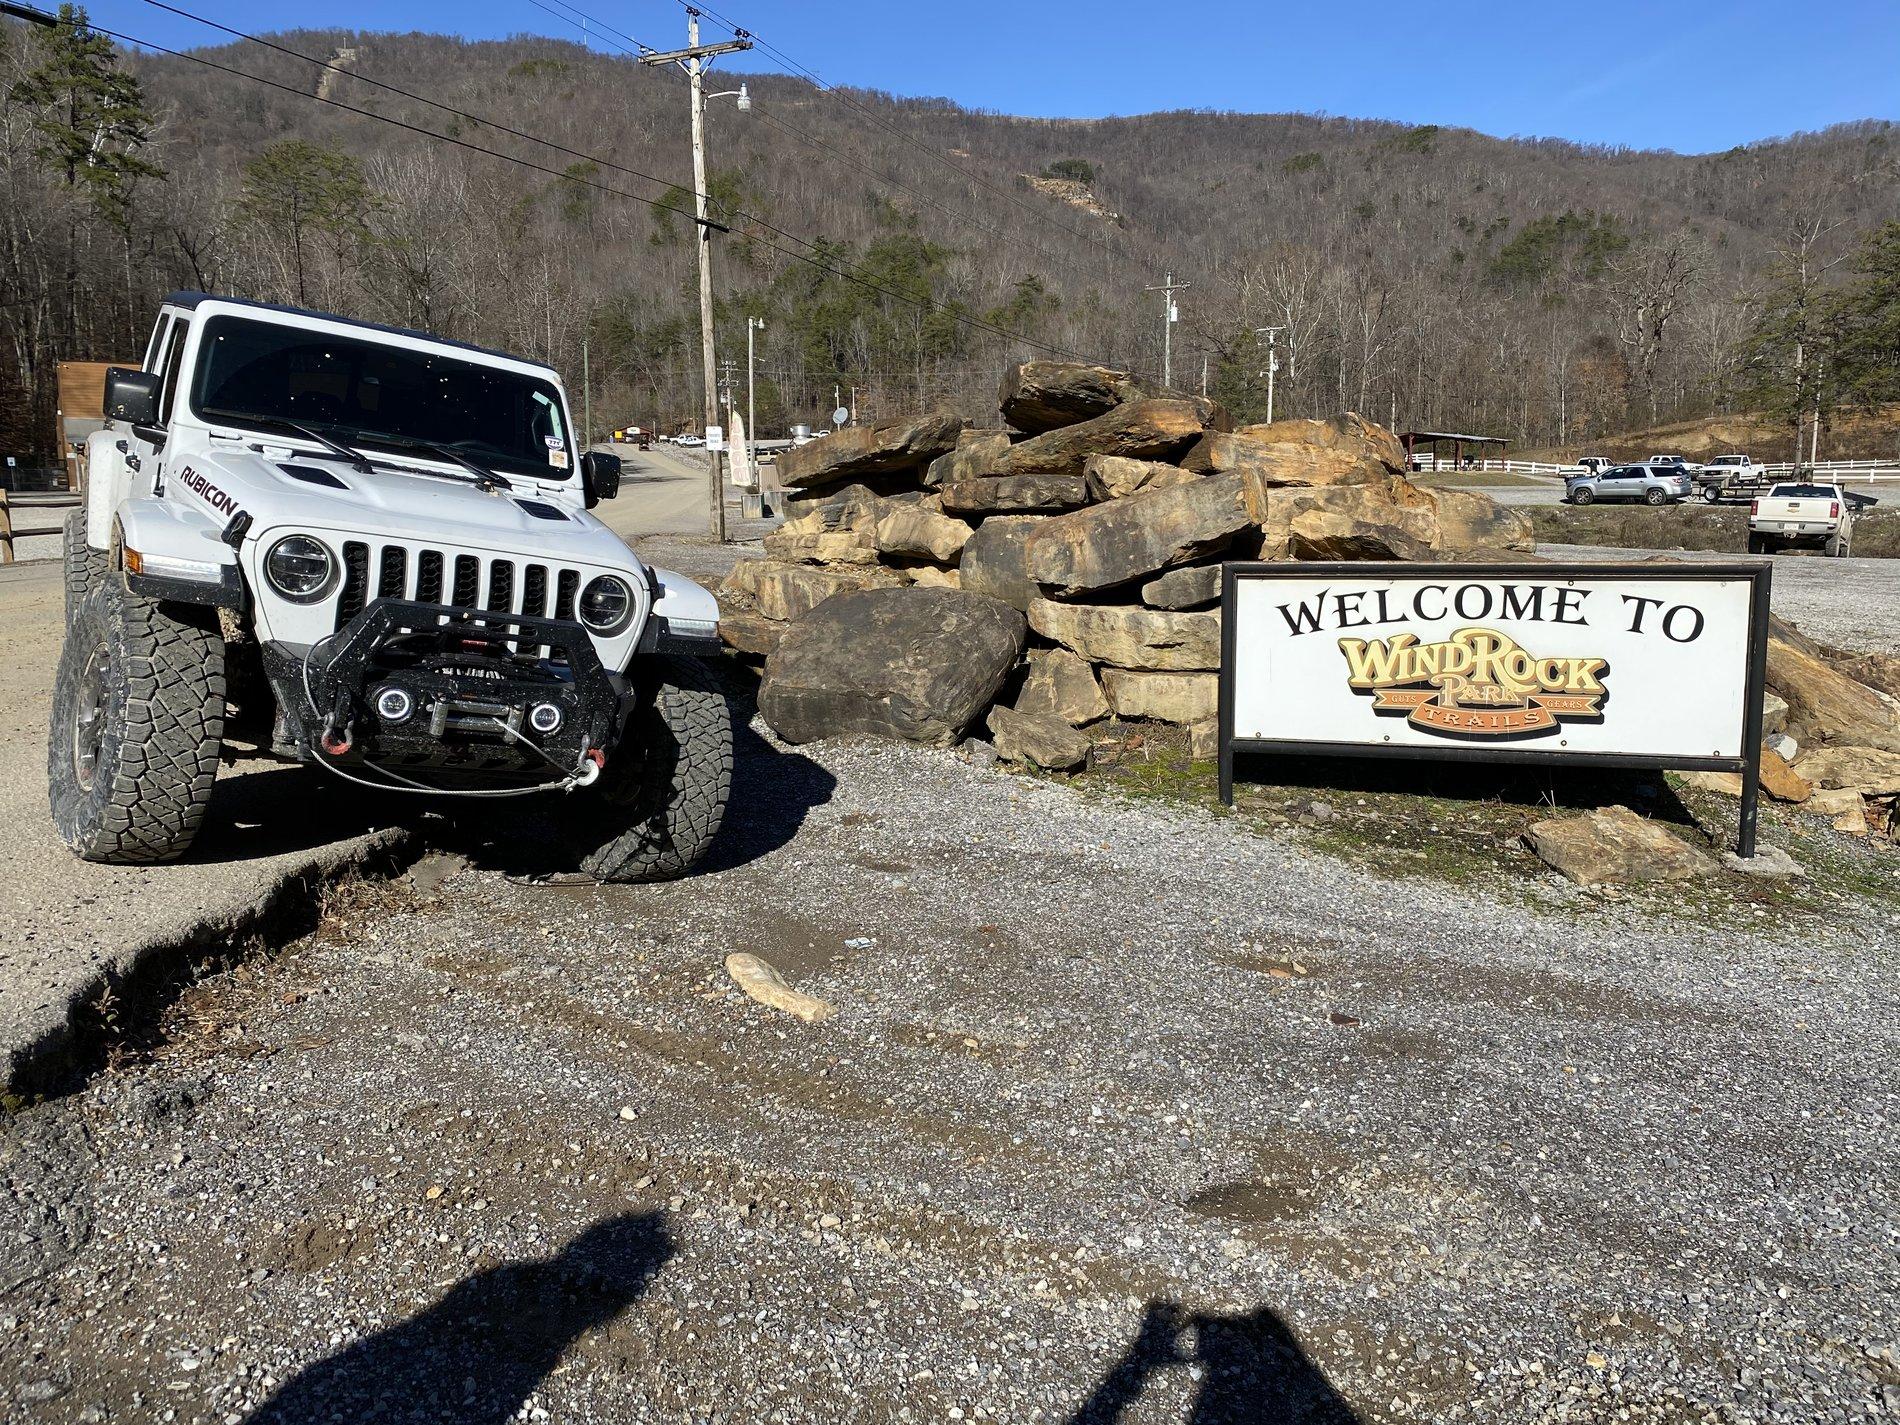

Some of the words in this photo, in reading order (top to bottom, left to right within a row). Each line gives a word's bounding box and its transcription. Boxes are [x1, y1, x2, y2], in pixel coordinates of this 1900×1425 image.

[180, 465, 240, 518] RUBICON
[1275, 584, 1594, 637] WELCOME
[1621, 594, 1706, 643] TO
[1391, 695, 1417, 704] GUTS
[1430, 674, 1521, 707] PARK
[1546, 699, 1583, 710] GEARS
[1426, 708, 1541, 728] TRAILS
